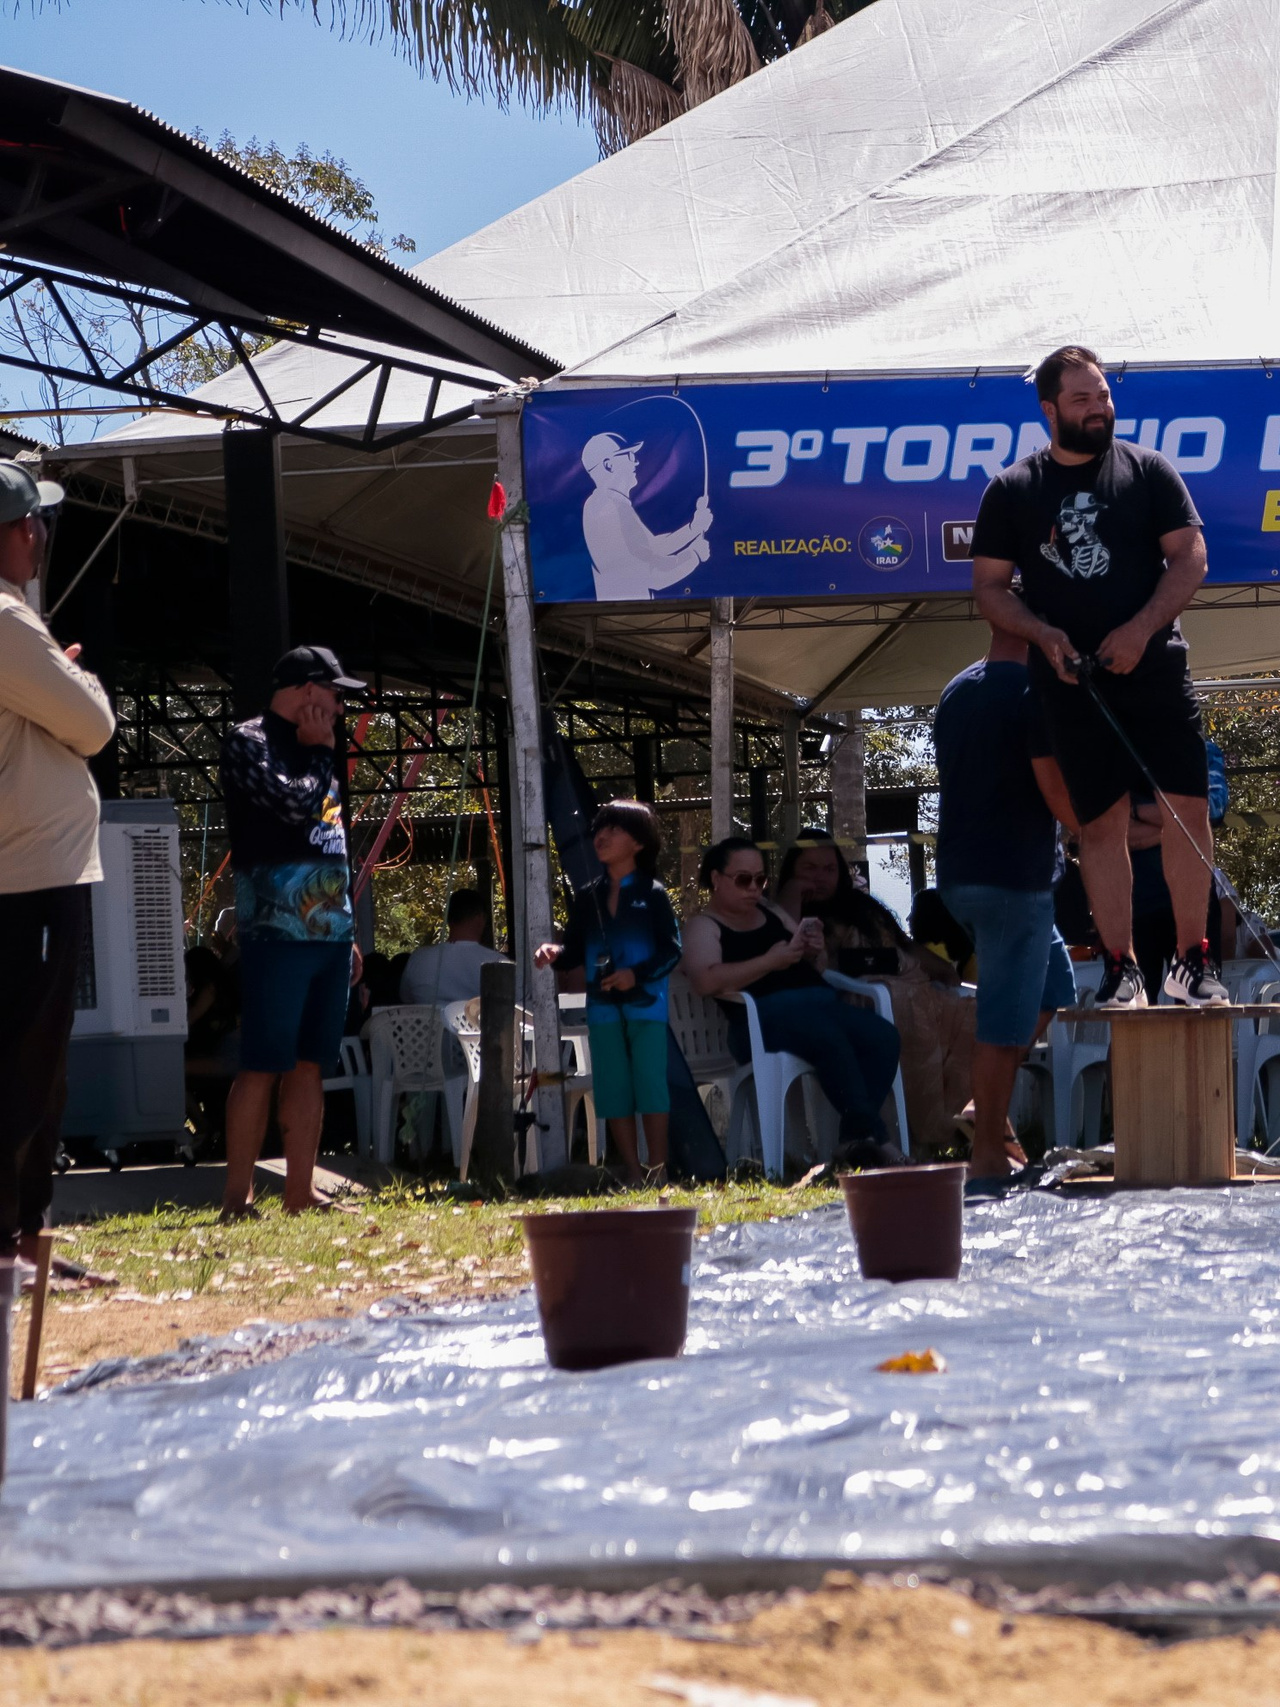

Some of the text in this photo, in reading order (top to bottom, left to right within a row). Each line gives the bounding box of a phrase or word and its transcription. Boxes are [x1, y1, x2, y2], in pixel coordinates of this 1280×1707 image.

[729, 429, 823, 487] 3º
[734, 535, 852, 557] REALIZAÇÃO:
[876, 556, 898, 565] IRAD
